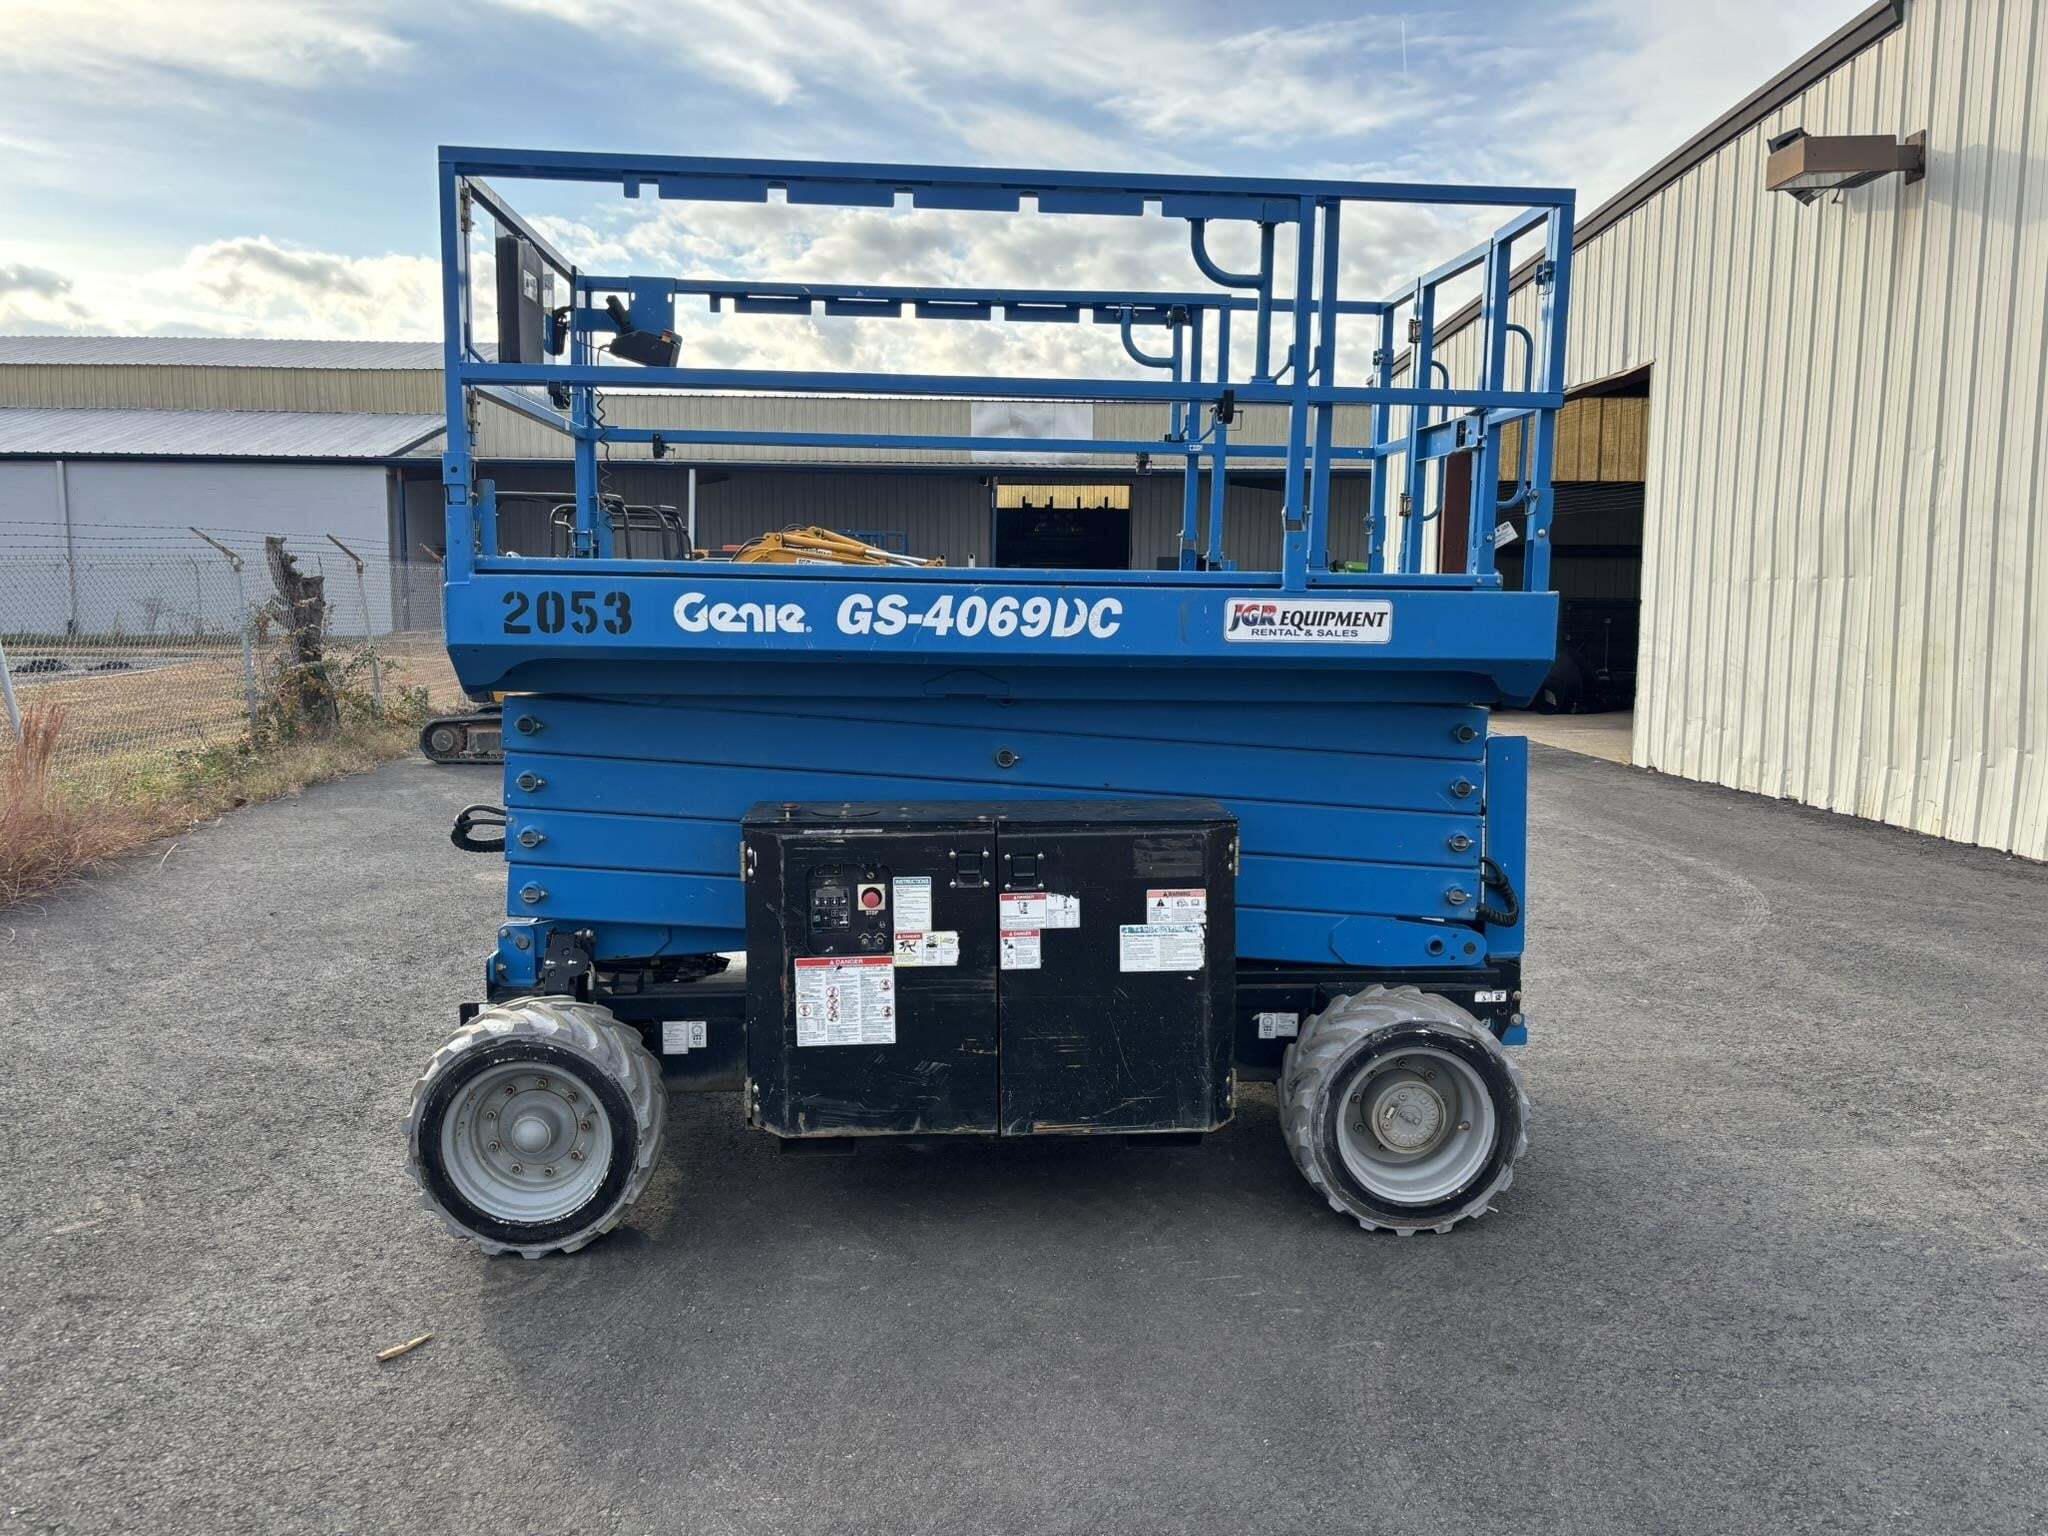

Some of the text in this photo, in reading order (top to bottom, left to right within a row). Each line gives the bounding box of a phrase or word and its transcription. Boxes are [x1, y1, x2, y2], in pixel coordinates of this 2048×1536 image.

[502, 591, 632, 635] 2053
[673, 592, 807, 633] Genie
[836, 593, 1123, 639] GS-4069DC
[1228, 603, 1389, 632] JGR EQUIPMENT
[1251, 628, 1359, 638] RENTAL & SALES
